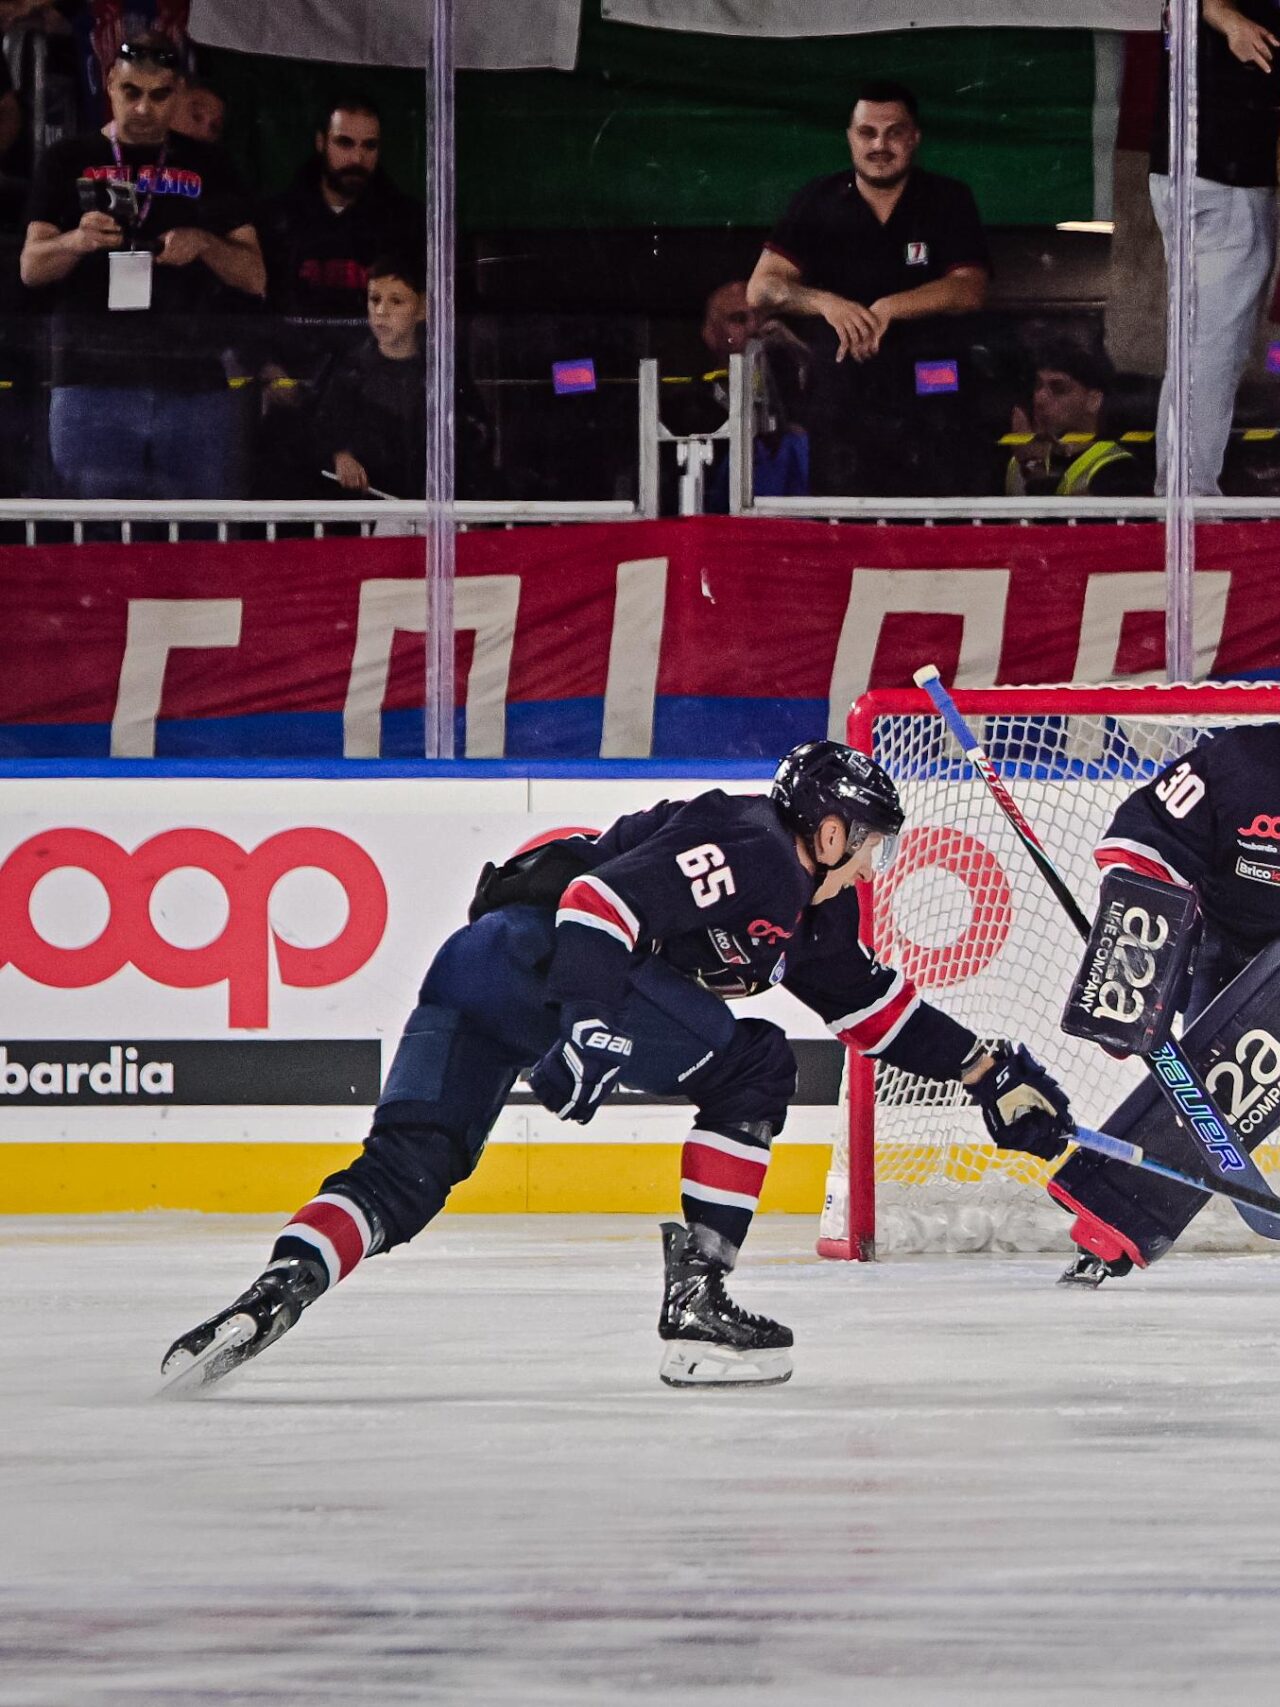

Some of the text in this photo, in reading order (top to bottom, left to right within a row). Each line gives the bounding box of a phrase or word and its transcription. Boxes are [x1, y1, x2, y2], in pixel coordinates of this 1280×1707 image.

[1155, 762, 1205, 819] 30
[676, 843, 735, 908] 65
[0, 827, 387, 1028] oop
[1092, 906, 1169, 1023] a2a
